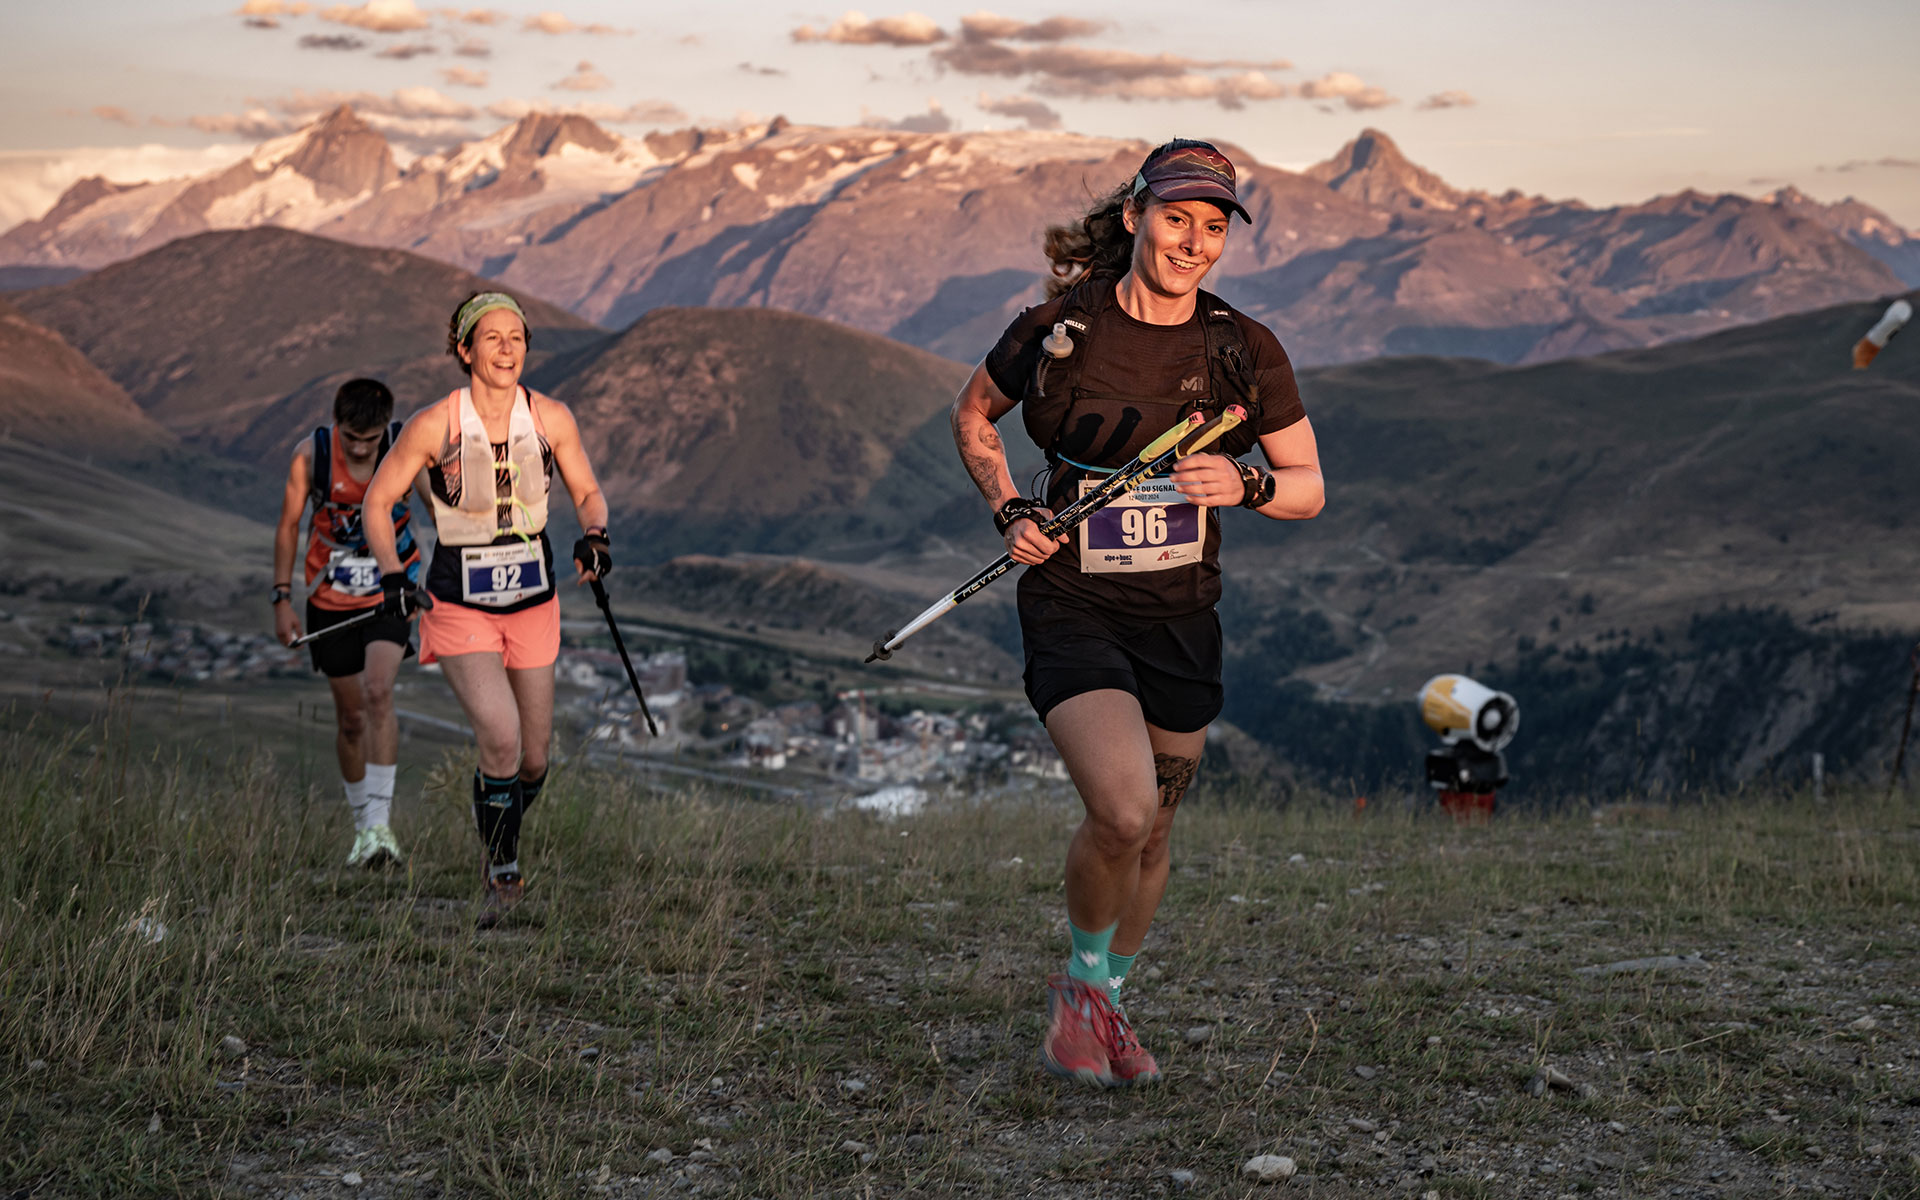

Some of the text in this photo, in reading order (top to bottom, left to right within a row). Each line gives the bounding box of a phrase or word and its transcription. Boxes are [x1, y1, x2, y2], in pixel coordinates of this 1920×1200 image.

[1124, 467, 1154, 492] LEKI
[1152, 484, 1177, 492] SIGNAL
[1121, 507, 1168, 547] 96
[350, 566, 375, 587] 35
[491, 564, 522, 592] 92
